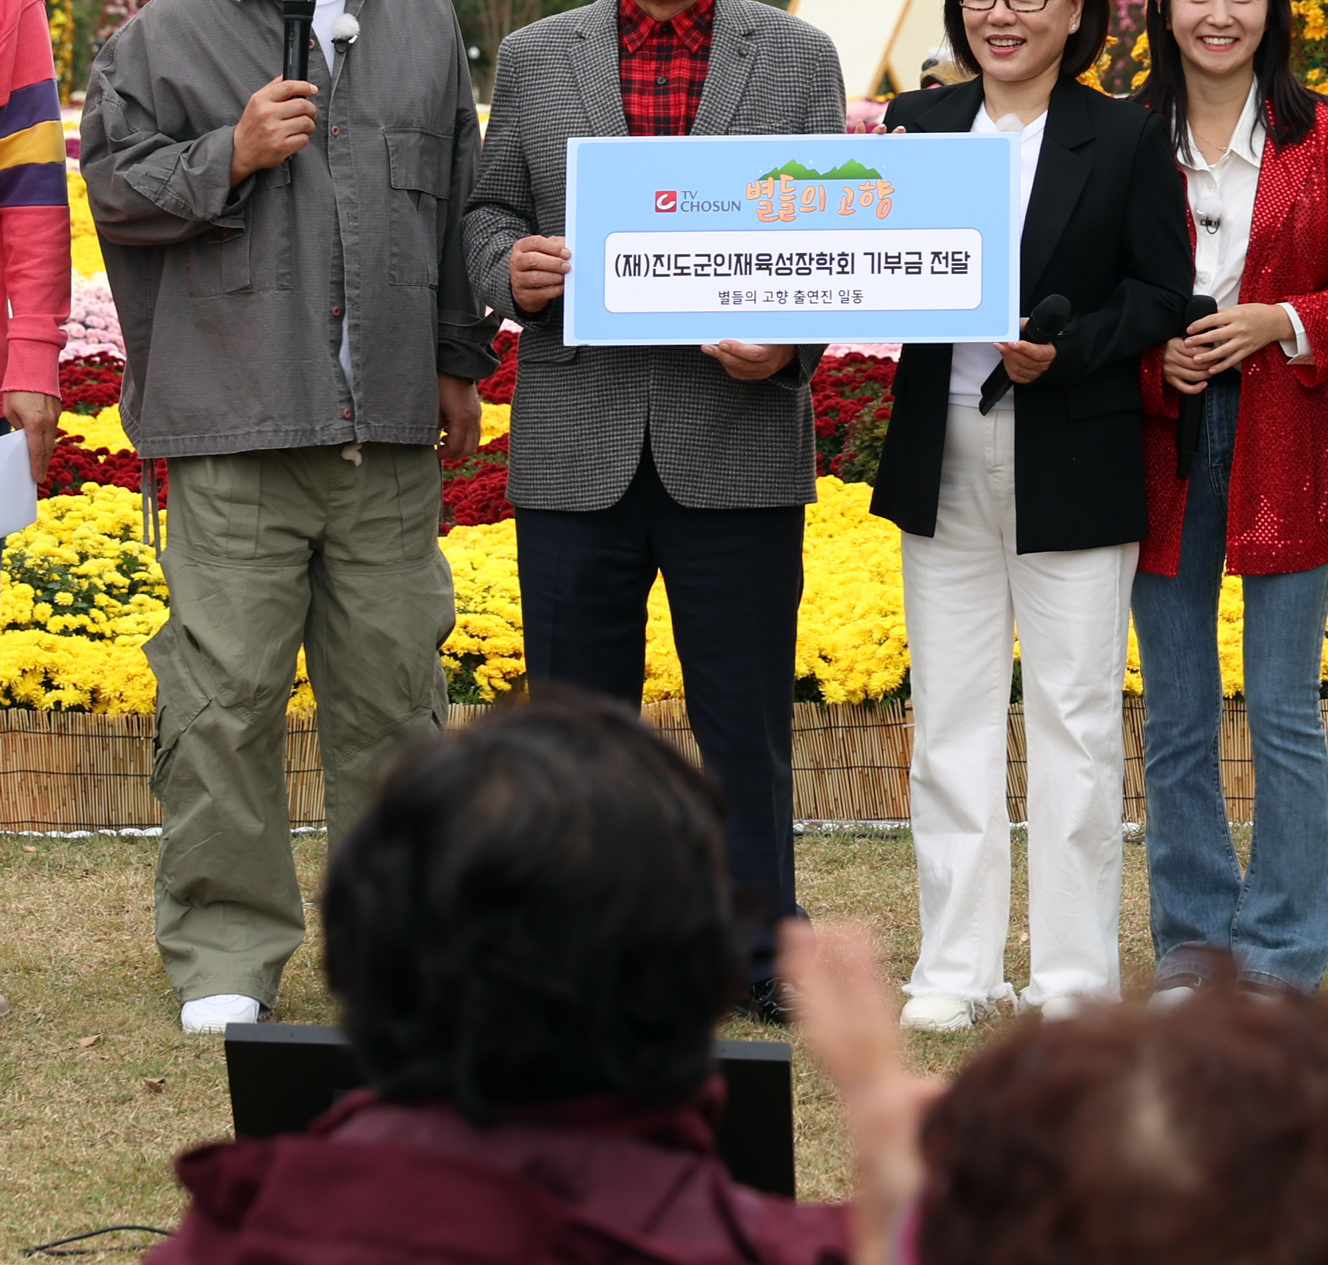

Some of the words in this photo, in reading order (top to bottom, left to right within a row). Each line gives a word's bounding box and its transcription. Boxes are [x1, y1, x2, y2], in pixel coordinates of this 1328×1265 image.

[680, 190, 698, 200] TV
[745, 174, 826, 223] 별들의
[838, 178, 895, 219] 고향
[680, 200, 741, 212] CHOSUN
[615, 251, 855, 278] (재)진도군인재육성장학회
[863, 251, 923, 275] 기부금
[930, 250, 971, 275] 전달
[718, 290, 757, 305] 별들의
[762, 290, 788, 305] 고향
[793, 289, 833, 305] 출연진
[838, 289, 864, 304] 일동
